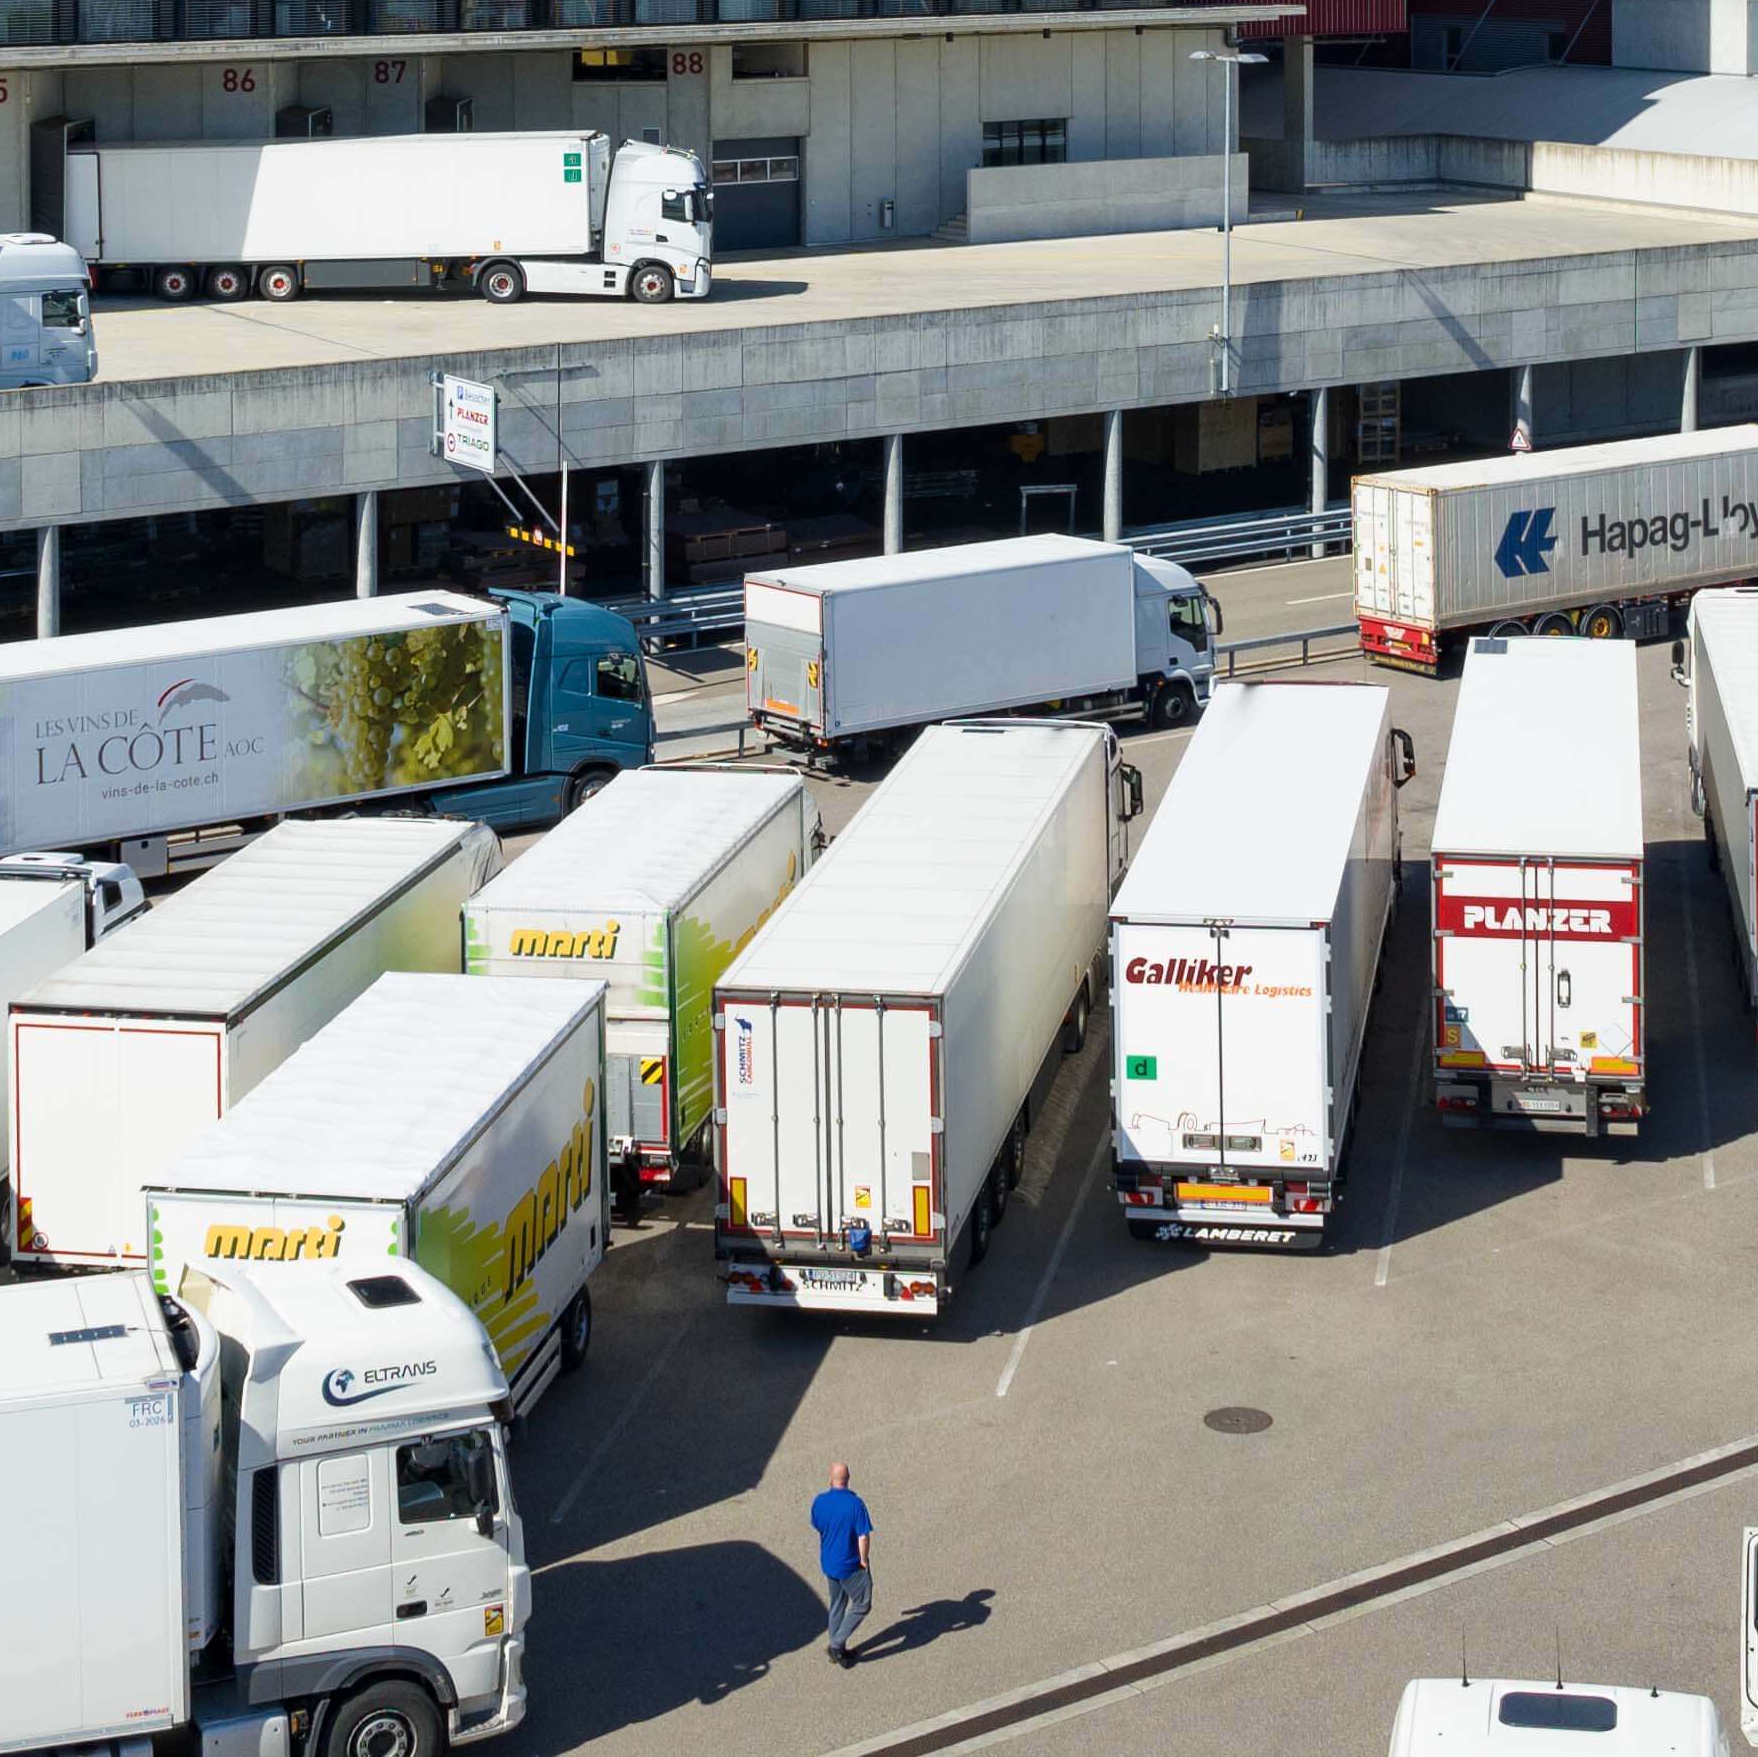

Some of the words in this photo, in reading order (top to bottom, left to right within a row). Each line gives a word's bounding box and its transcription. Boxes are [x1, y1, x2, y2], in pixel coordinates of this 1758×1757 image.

[374, 60, 406, 84] 87
[672, 52, 704, 75] 88
[223, 68, 255, 93] 86
[457, 407, 489, 426] PLANZER
[457, 433, 490, 452] TRIAGO
[36, 720, 64, 739] LES
[67, 712, 110, 733] VINS
[114, 709, 140, 728] DE
[36, 742, 88, 785] LA
[98, 722, 218, 776] CÔTE
[224, 737, 265, 758] AOC
[101, 770, 219, 800] vins-de-la-cote.ch
[1463, 905, 1613, 933] PLANZER
[509, 919, 620, 960] marti
[1125, 956, 1253, 987] Galliker
[1178, 978, 1251, 996] Healthcare
[1254, 982, 1313, 997] Logistics
[738, 1035, 748, 1084] SCHMITZ
[746, 1034, 754, 1085] CARGOBULL
[1135, 1059, 1148, 1077] d
[505, 1076, 595, 1307] marti
[204, 1213, 346, 1262] marti
[1183, 1225, 1297, 1244] LAMBERET
[802, 1280, 865, 1293] SCHMITZ
[363, 1360, 438, 1385] ELTRANS
[132, 1400, 163, 1418] FRC
[293, 1435, 316, 1446] YOUR
[317, 1429, 357, 1443] PARTNER
[358, 1427, 368, 1436] IN
